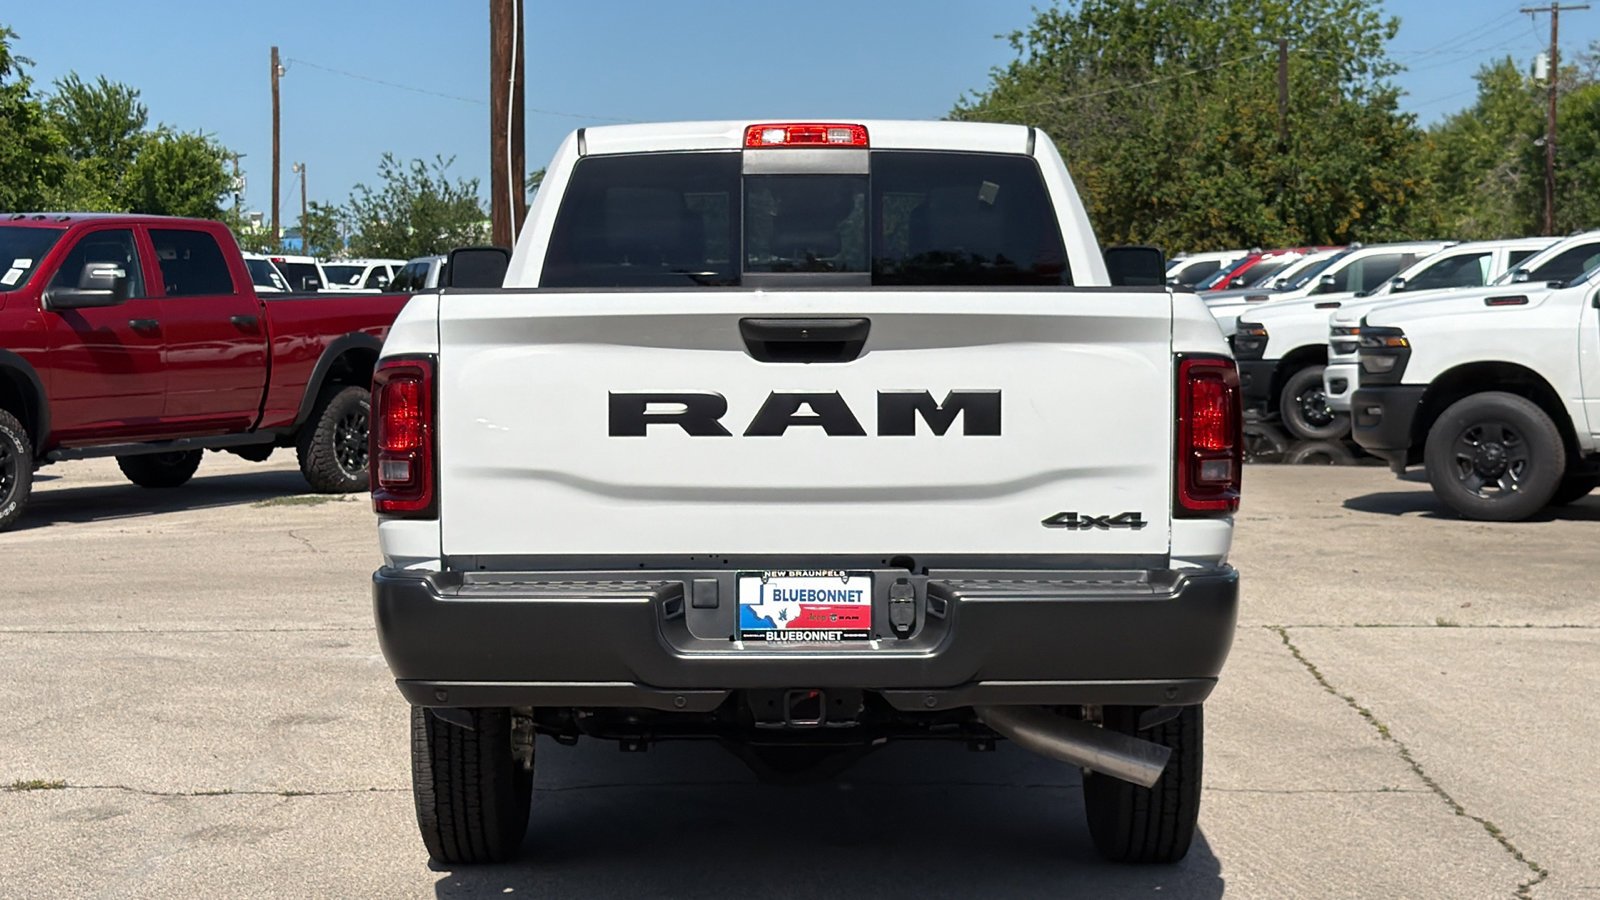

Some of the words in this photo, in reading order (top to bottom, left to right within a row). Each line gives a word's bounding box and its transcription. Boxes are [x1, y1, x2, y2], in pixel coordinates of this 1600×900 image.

[608, 388, 1002, 437] RAM
[1041, 511, 1148, 531] 4x4
[773, 589, 863, 602] BLUEBONNET
[766, 631, 843, 640] BLUEBONNET
